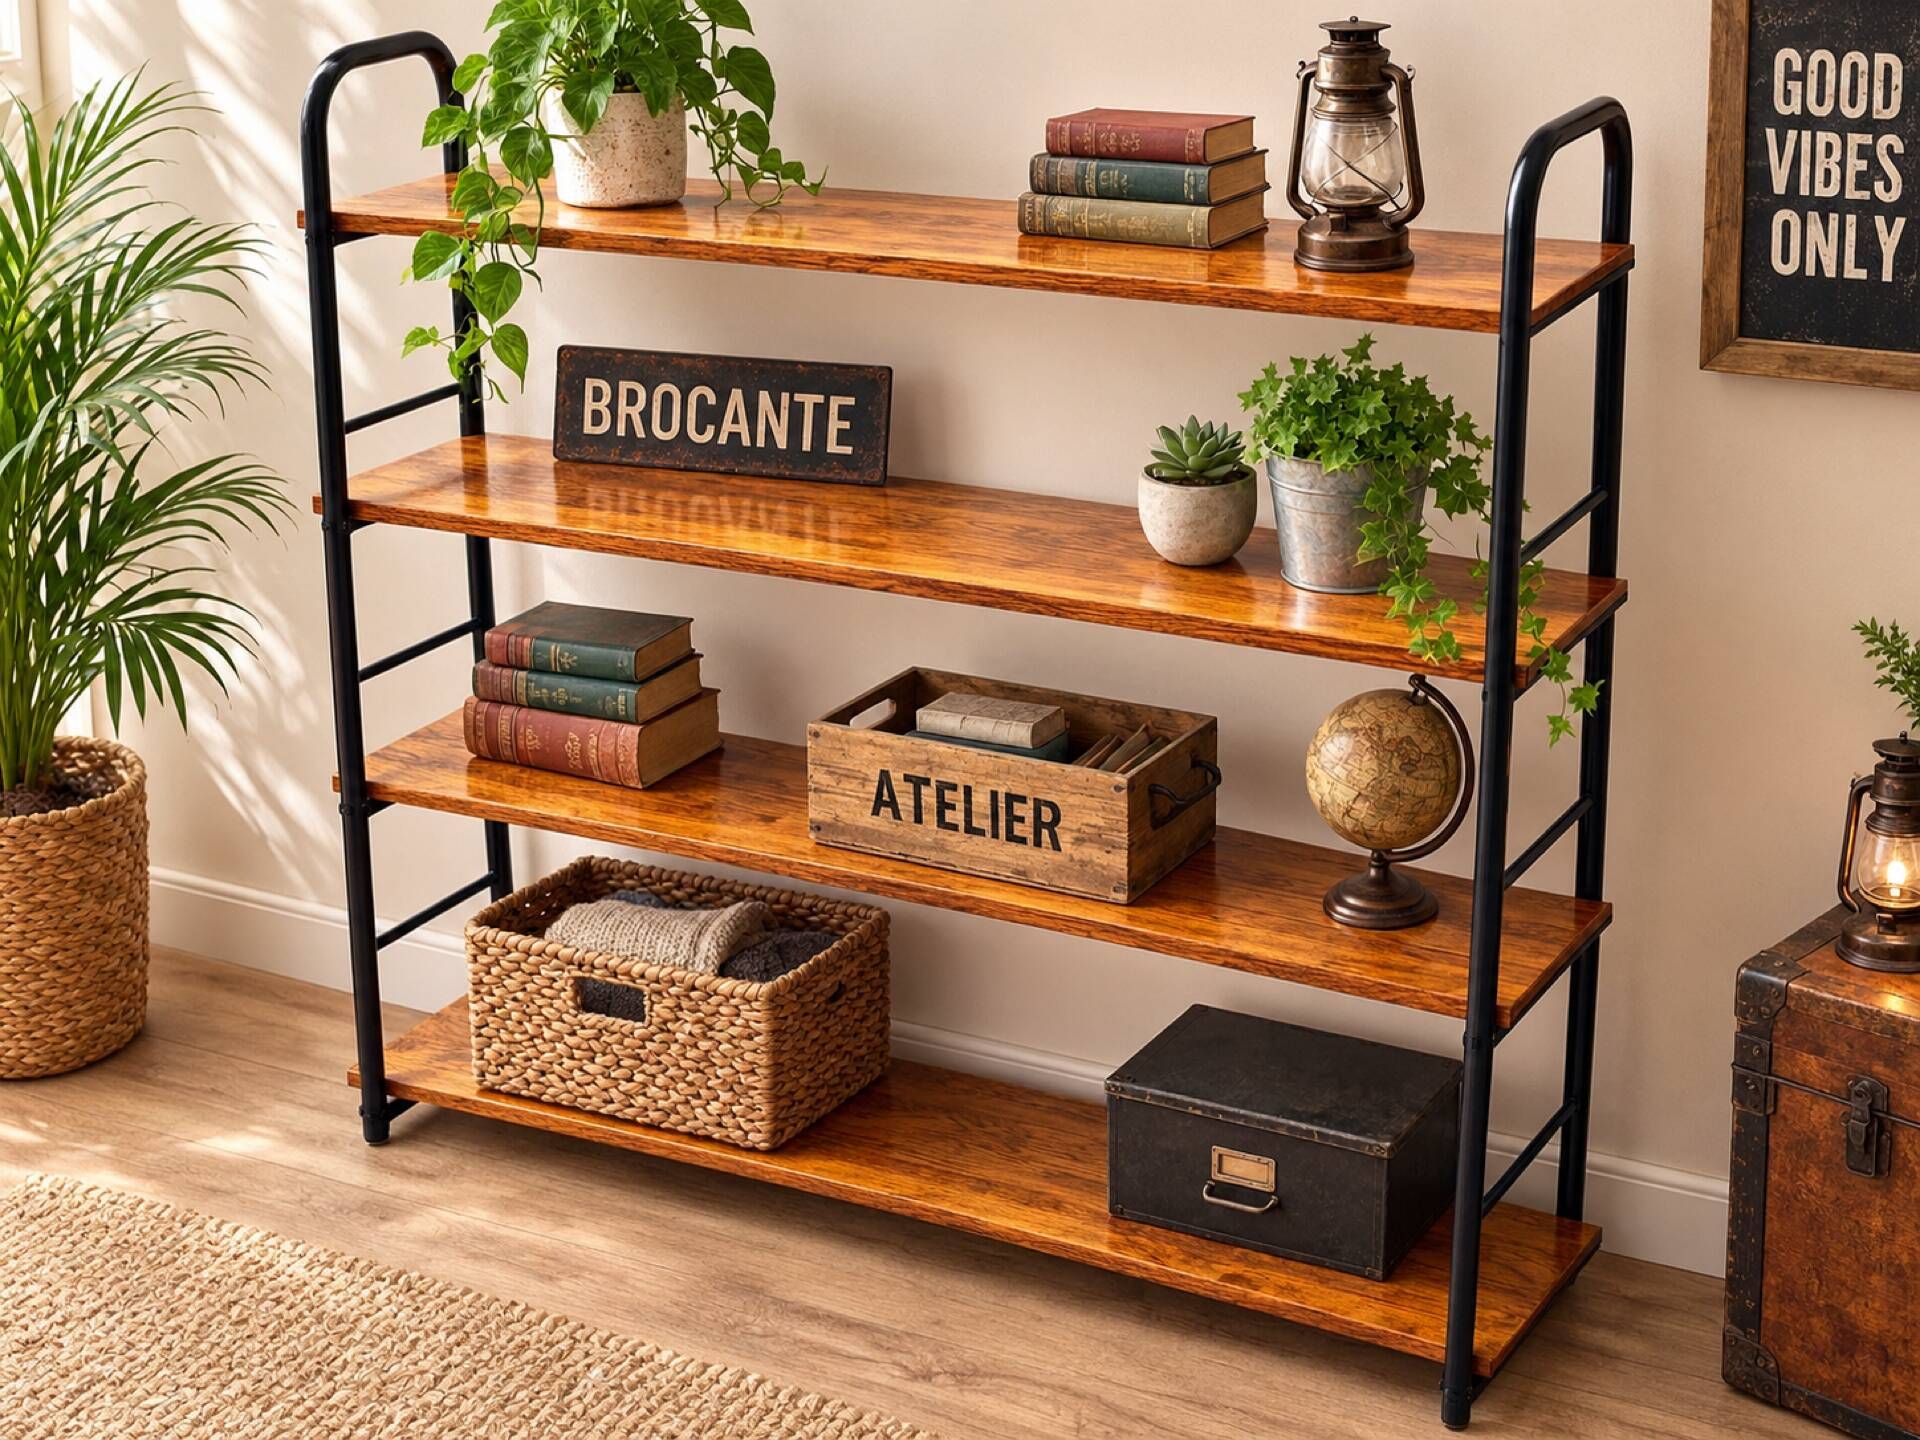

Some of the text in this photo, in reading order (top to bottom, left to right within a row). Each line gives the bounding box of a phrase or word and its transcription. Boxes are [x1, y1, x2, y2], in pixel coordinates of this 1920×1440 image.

[1774, 48, 1903, 120] GOOD
[1766, 128, 1905, 203] VIBES
[1771, 209, 1907, 282] ONLY
[583, 378, 856, 455] BROCANTE
[871, 769, 1062, 851] ATELIER
